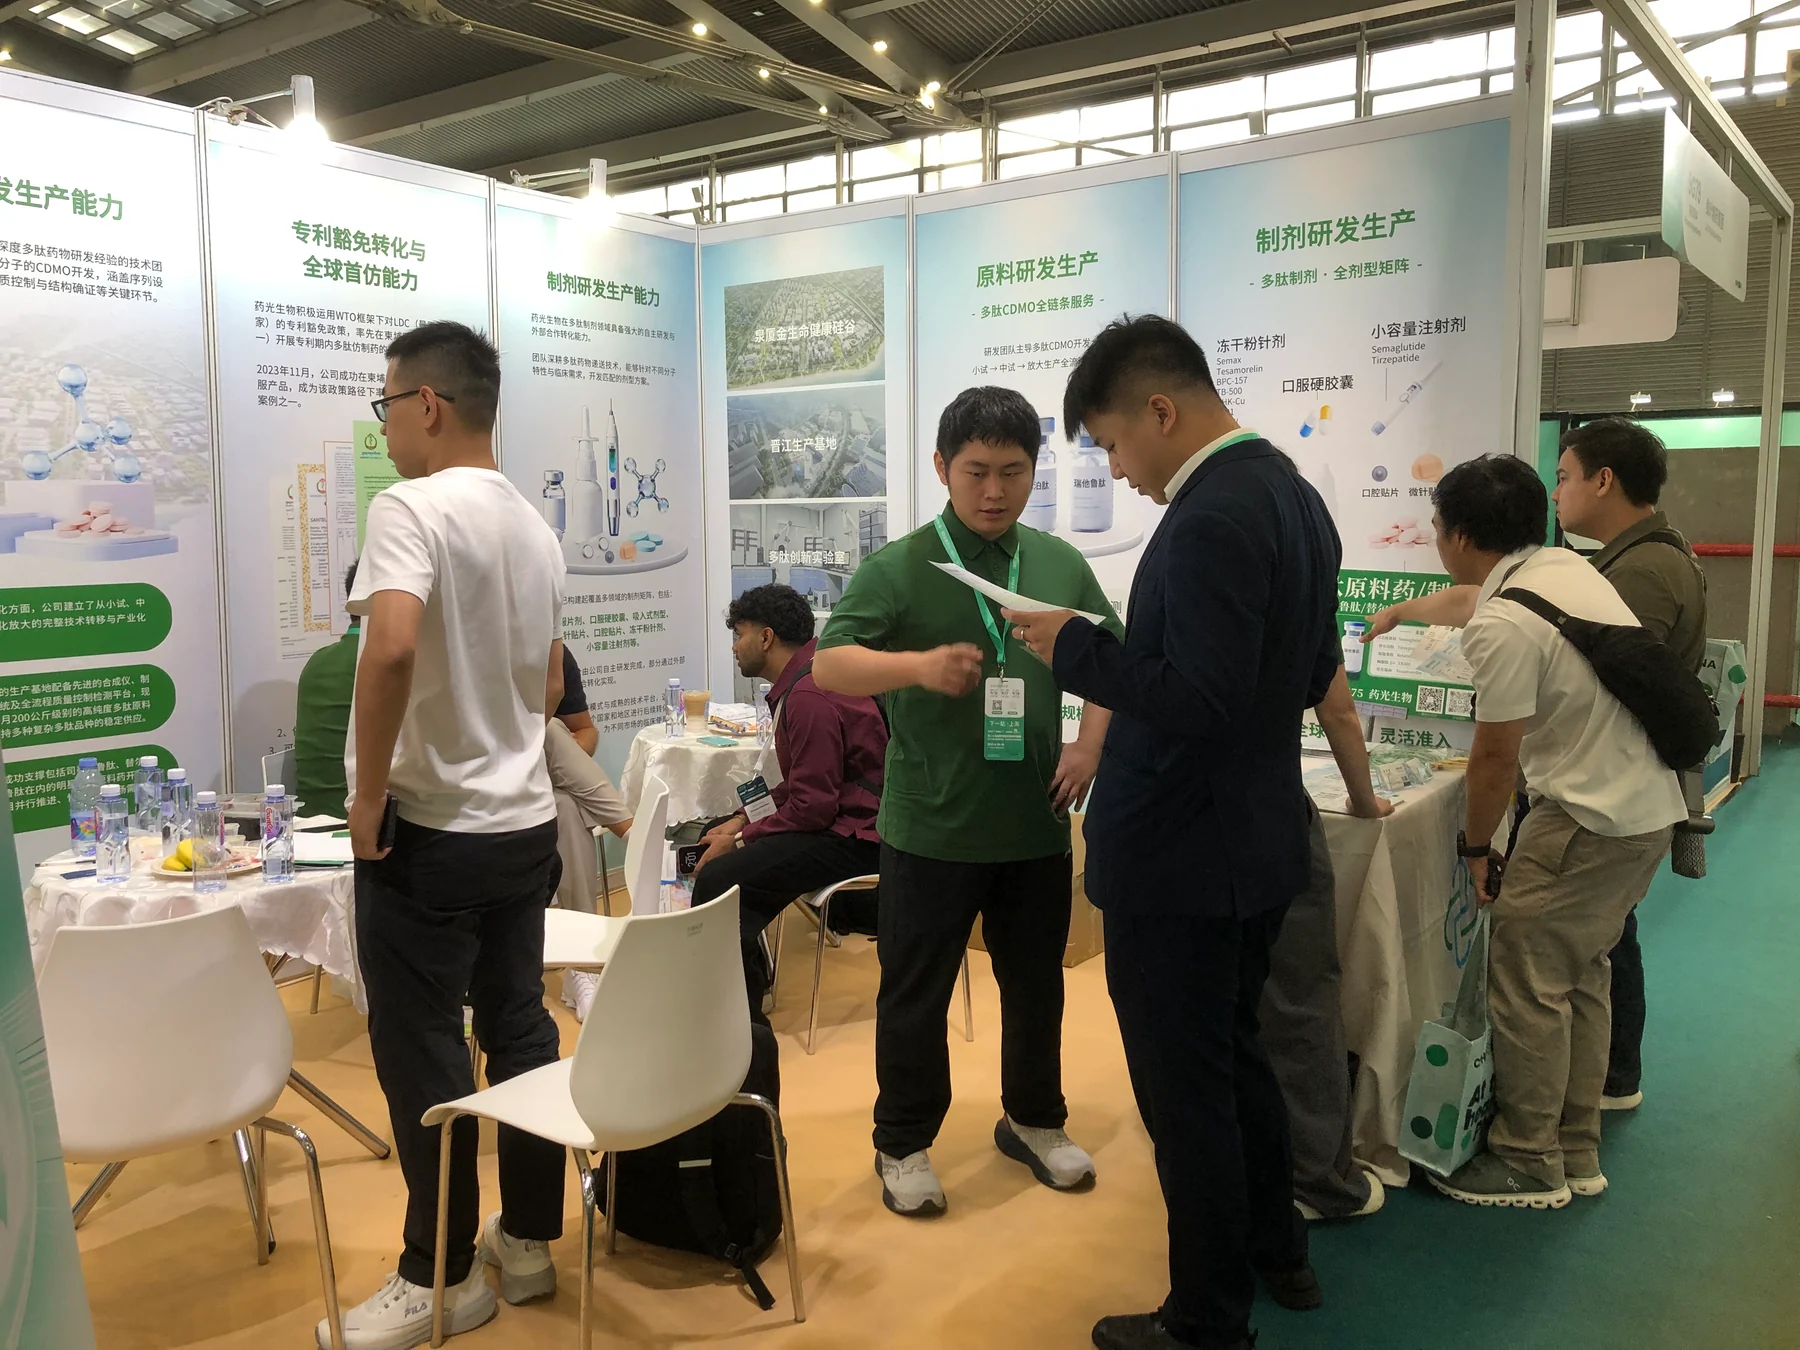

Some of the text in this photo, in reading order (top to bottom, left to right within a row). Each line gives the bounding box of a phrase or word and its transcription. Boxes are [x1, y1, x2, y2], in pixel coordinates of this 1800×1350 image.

[0, 176, 123, 221] 发生产能力
[1256, 208, 1416, 254] 制剂研发生产
[291, 220, 426, 262] 专利豁免转化与
[0, 240, 163, 273] 深度多肽药物研发经验的技术团
[0, 257, 163, 288] 分子的CDMO开发，涵盖序列设
[302, 255, 418, 291] 全球首仿能力
[976, 250, 1099, 288] 原料研发生产
[1261, 268, 1318, 289] 多肽制剂
[1333, 258, 1410, 281] 全剂型矩阵
[0, 274, 158, 303] 质控制与结构确证等关键环节。
[547, 271, 660, 307] 制剂研发生产能力
[981, 294, 1094, 319] 多肽CDMO全链条服务
[531, 313, 675, 341] 药光生物在多肽制剂领域具备强大的自主研发与
[531, 327, 591, 342] 外部合作转化能力。
[755, 319, 856, 343] 泉厦金生命健康硅谷
[1371, 316, 1467, 339] 小容量注射剂
[1217, 333, 1286, 353] 冻干粉针剂
[1372, 342, 1426, 354] Semaglutide
[1027, 356, 1081, 371] 放大生产全流
[1217, 357, 1242, 366] Semax
[1372, 353, 1420, 365] Tirzepatide
[1217, 364, 1263, 376] Tesamorelin
[1217, 376, 1248, 386] BPC-157
[1283, 375, 1354, 393] 口服硬胶囊
[1217, 387, 1243, 396] TB-500
[258, 395, 303, 408] 案例之一。
[1222, 397, 1245, 405] HK-Cu
[770, 437, 837, 453] 晋江生产基地
[1074, 478, 1106, 488] 瑞他鲁肽
[1362, 487, 1399, 498] 口腔贴片
[768, 550, 846, 565] 多肽创新实验室
[1339, 601, 1392, 614] 鲁肽/替尔
[586, 638, 640, 652] 小容量注射剂等。
[1349, 688, 1413, 703] 75 药光生物
[1380, 727, 1452, 748] 灵活准入
[404, 1302, 427, 1318] FILA
